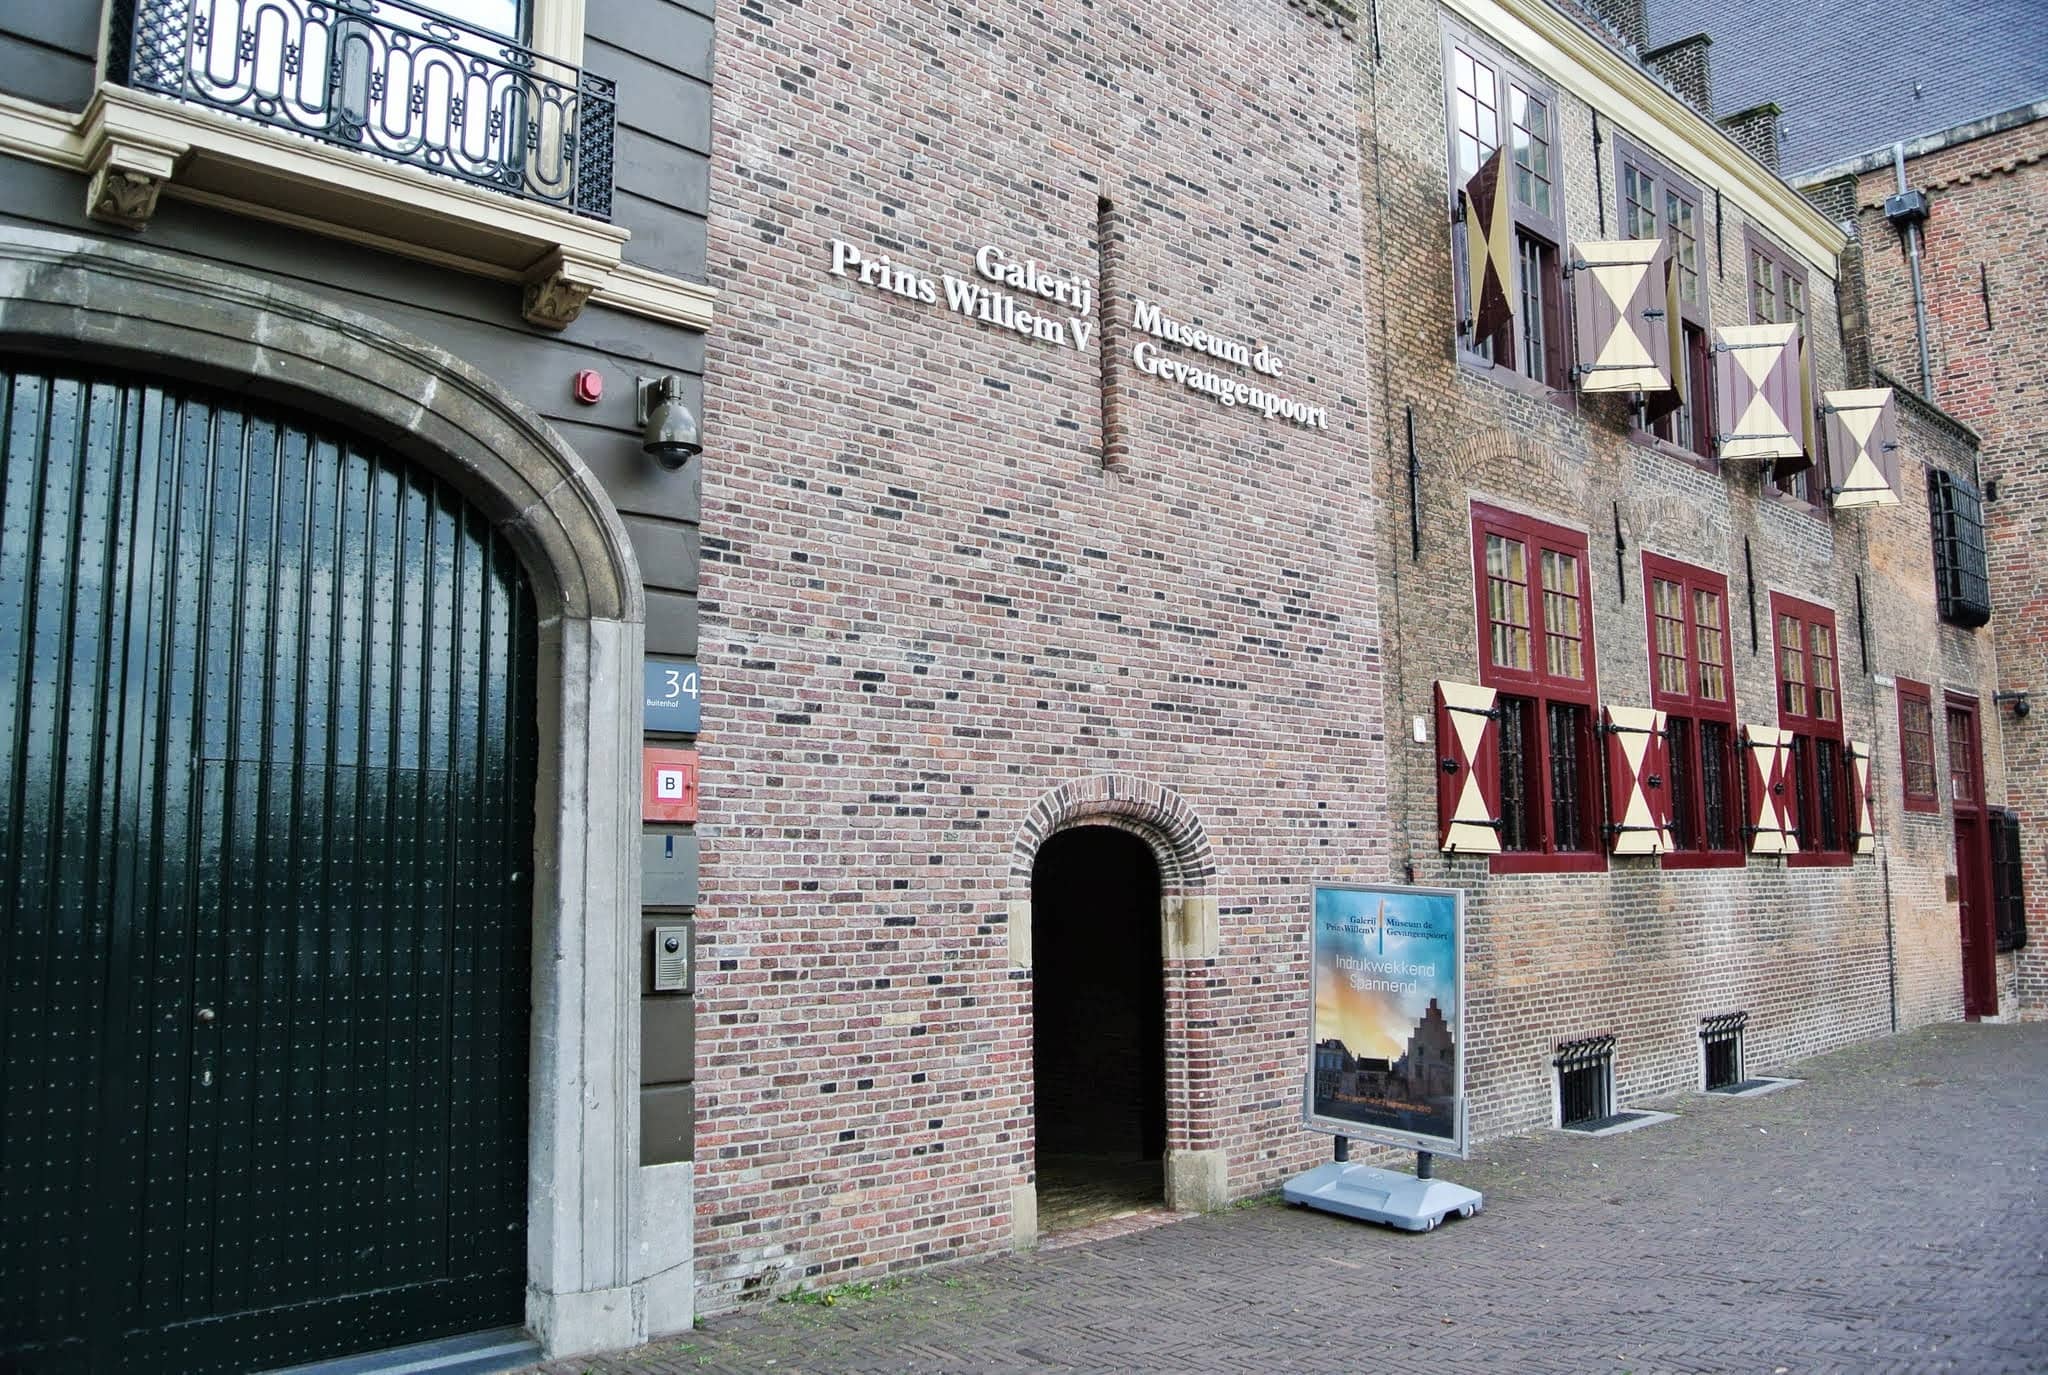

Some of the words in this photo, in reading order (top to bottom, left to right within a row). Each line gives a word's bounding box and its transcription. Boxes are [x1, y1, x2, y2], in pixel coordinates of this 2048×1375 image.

[976, 245, 1092, 316] Galerij
[828, 238, 937, 303] Prins
[942, 274, 1066, 345] Willem
[1069, 316, 1093, 351] V
[1132, 299, 1250, 367] Museum
[1253, 345, 1284, 377] de
[1133, 342, 1329, 429] Gevangenpoort
[665, 670, 699, 699] 34
[646, 698, 680, 708] Buitenhof
[665, 776, 676, 790] B
[1343, 924, 1370, 934] Willem
[1350, 914, 1377, 926] Galerij
[1386, 917, 1422, 929] Museum
[1423, 920, 1433, 929] de
[1386, 927, 1448, 940] Gevangenpoort
[1336, 953, 1436, 977] Indrukwekkend
[1350, 972, 1417, 993] Spannend
